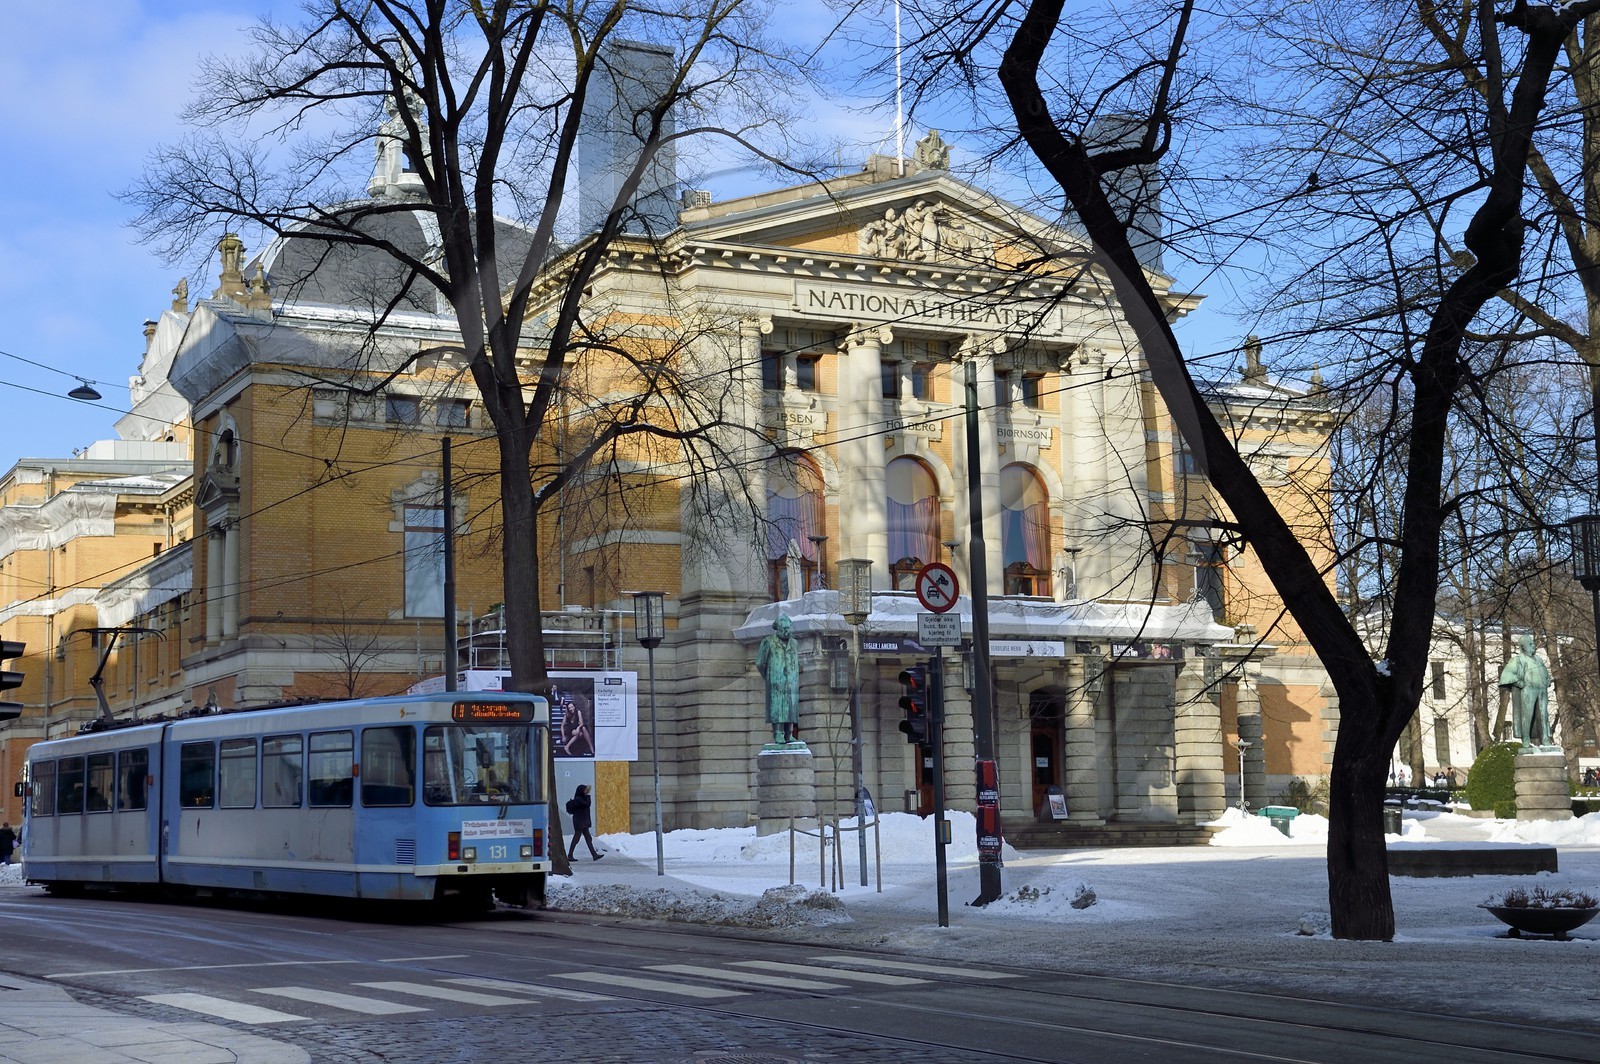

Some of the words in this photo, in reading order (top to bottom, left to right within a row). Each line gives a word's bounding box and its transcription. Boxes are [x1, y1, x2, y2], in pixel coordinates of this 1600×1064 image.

[808, 289, 1047, 329] NATIONALTHEATER
[776, 412, 813, 424] IBSEN
[886, 420, 936, 432] HOLBERG
[924, 616, 941, 624] Gjelder
[488, 845, 507, 859] 131
